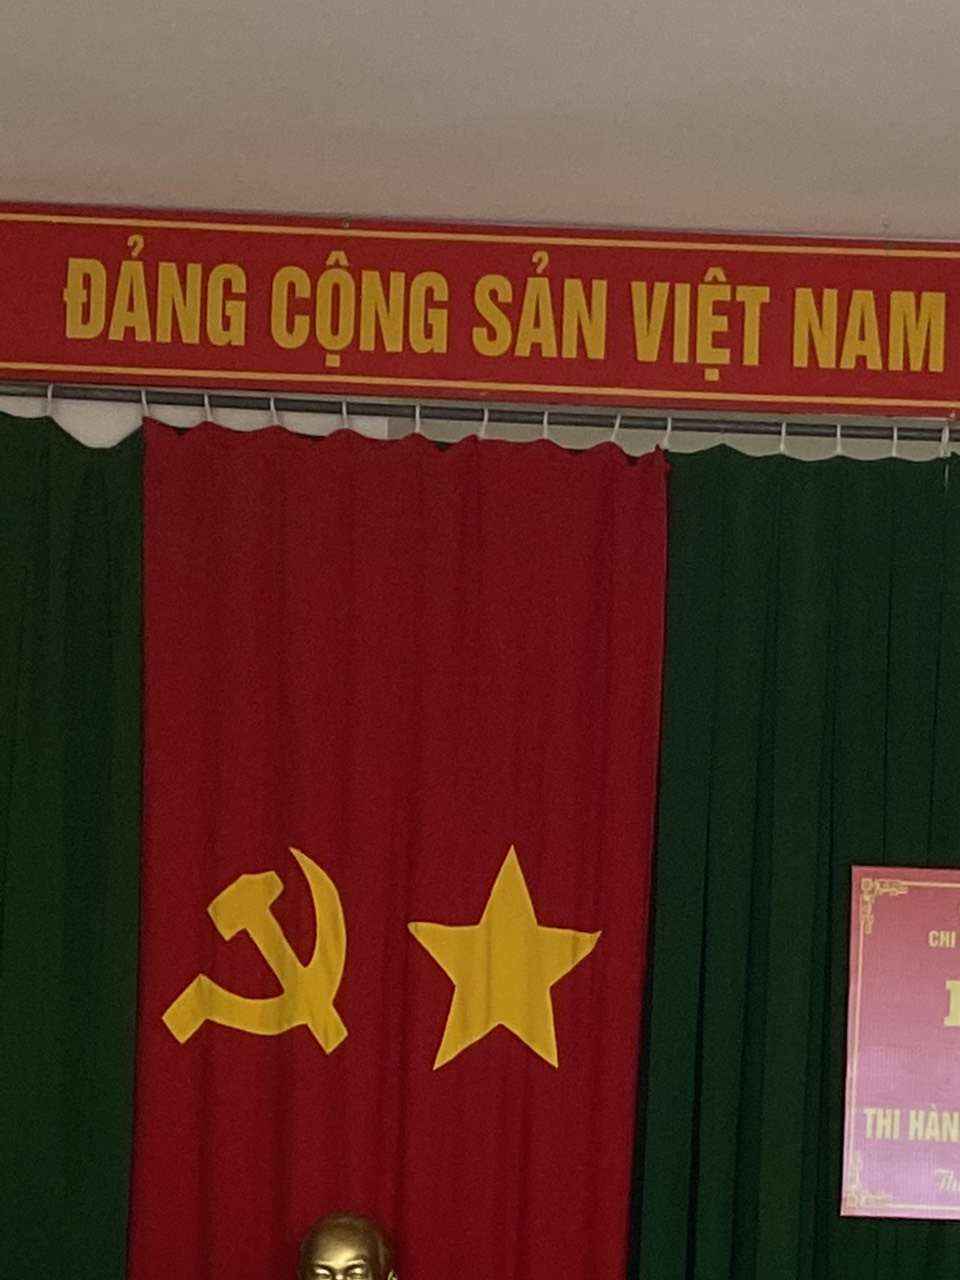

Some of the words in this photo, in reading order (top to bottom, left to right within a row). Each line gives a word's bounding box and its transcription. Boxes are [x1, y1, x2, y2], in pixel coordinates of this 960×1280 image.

[63, 234, 247, 347] ĐẢNG
[269, 250, 449, 367] CỘNG
[473, 250, 607, 360] SẢN
[631, 266, 771, 381] VIỆT
[793, 287, 946, 373] NAM
[928, 930, 956, 948] CHI
[863, 1107, 900, 1140] THI
